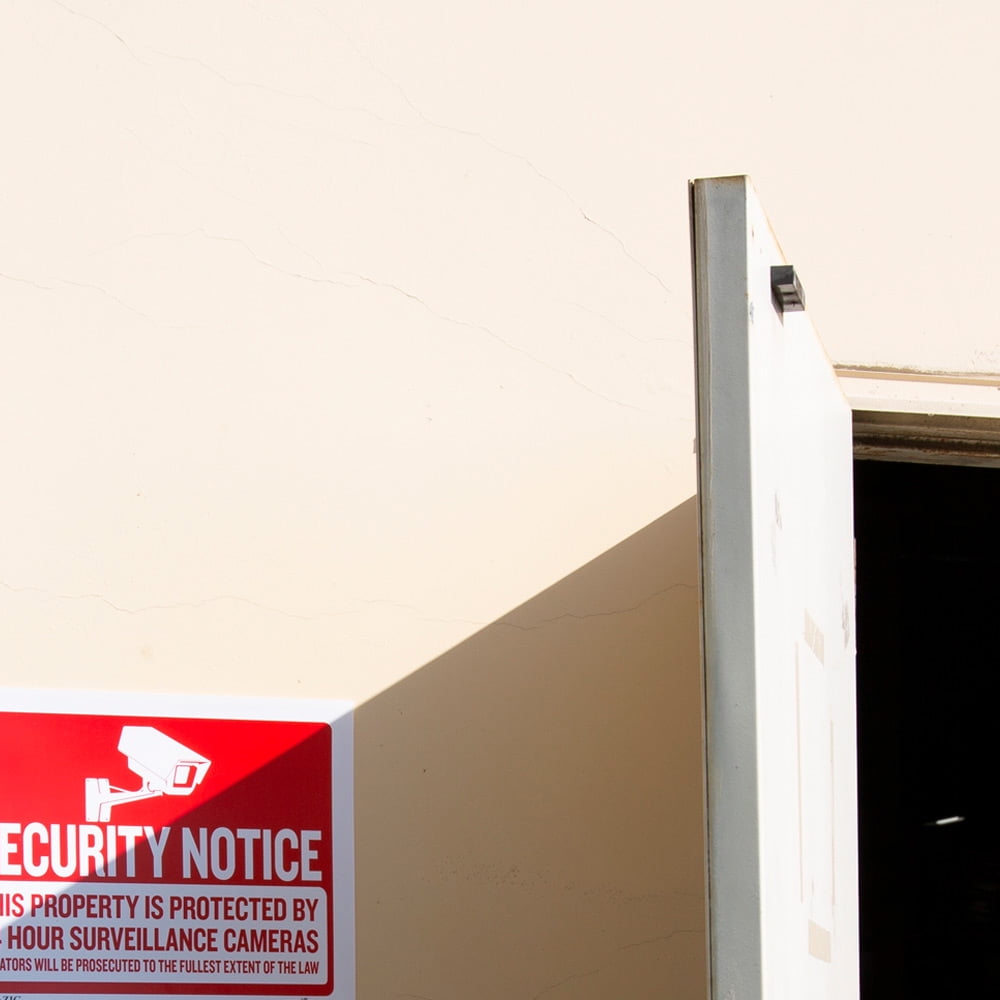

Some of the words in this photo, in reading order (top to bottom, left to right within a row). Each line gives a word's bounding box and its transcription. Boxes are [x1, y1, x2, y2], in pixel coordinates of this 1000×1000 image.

[182, 827, 322, 881] NOTICE
[31, 894, 139, 919] PROPERTY
[145, 895, 164, 920] IS
[170, 896, 287, 921] PROTECTED
[293, 898, 319, 922] BY
[8, 926, 64, 950] HOUR
[70, 927, 217, 952] SURVEILLANCE
[224, 928, 319, 953] CAMERAS
[34, 958, 59, 972] WILL
[61, 958, 74, 972] BE
[75, 959, 141, 973] PROSECUTED
[142, 959, 156, 973] TO
[158, 960, 177, 973] THE
[179, 960, 222, 974] FULLEST
[224, 961, 261, 974] EXTENT
[263, 961, 275, 974] OF
[277, 961, 296, 975] THE
[299, 962, 319, 975] LAW
